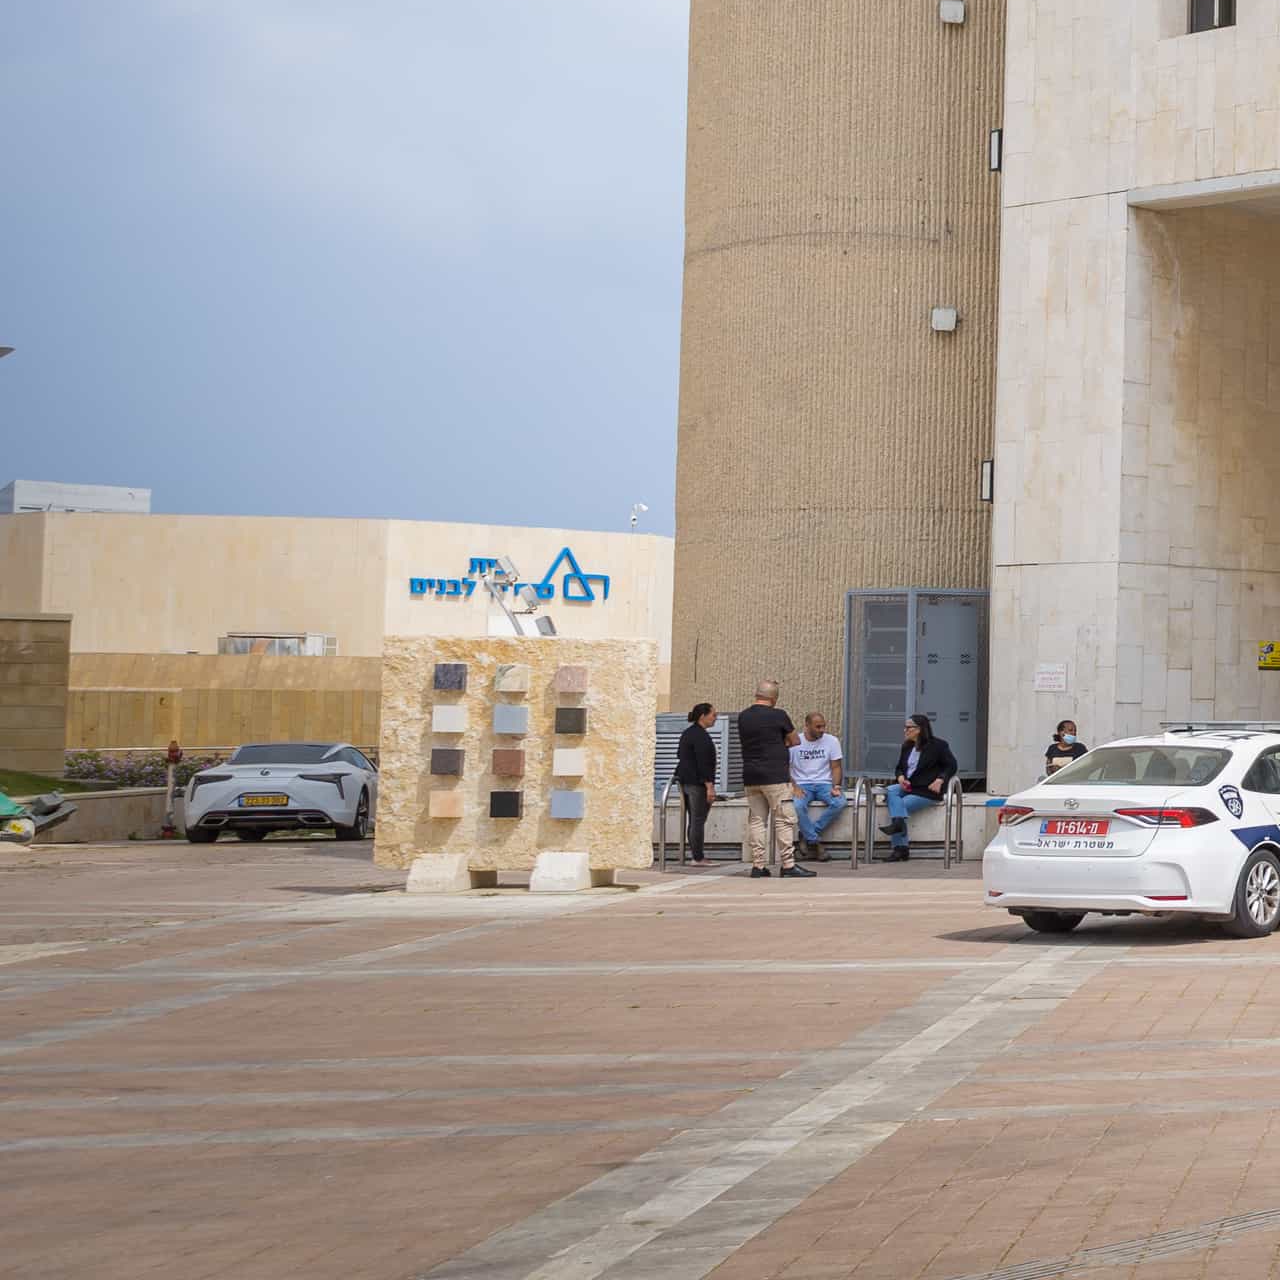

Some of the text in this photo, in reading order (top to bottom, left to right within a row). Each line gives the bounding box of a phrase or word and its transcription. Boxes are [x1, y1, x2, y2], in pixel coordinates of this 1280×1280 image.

[409, 577, 477, 596] לבנים
[1036, 838, 1114, 849] משטרת ישראל
